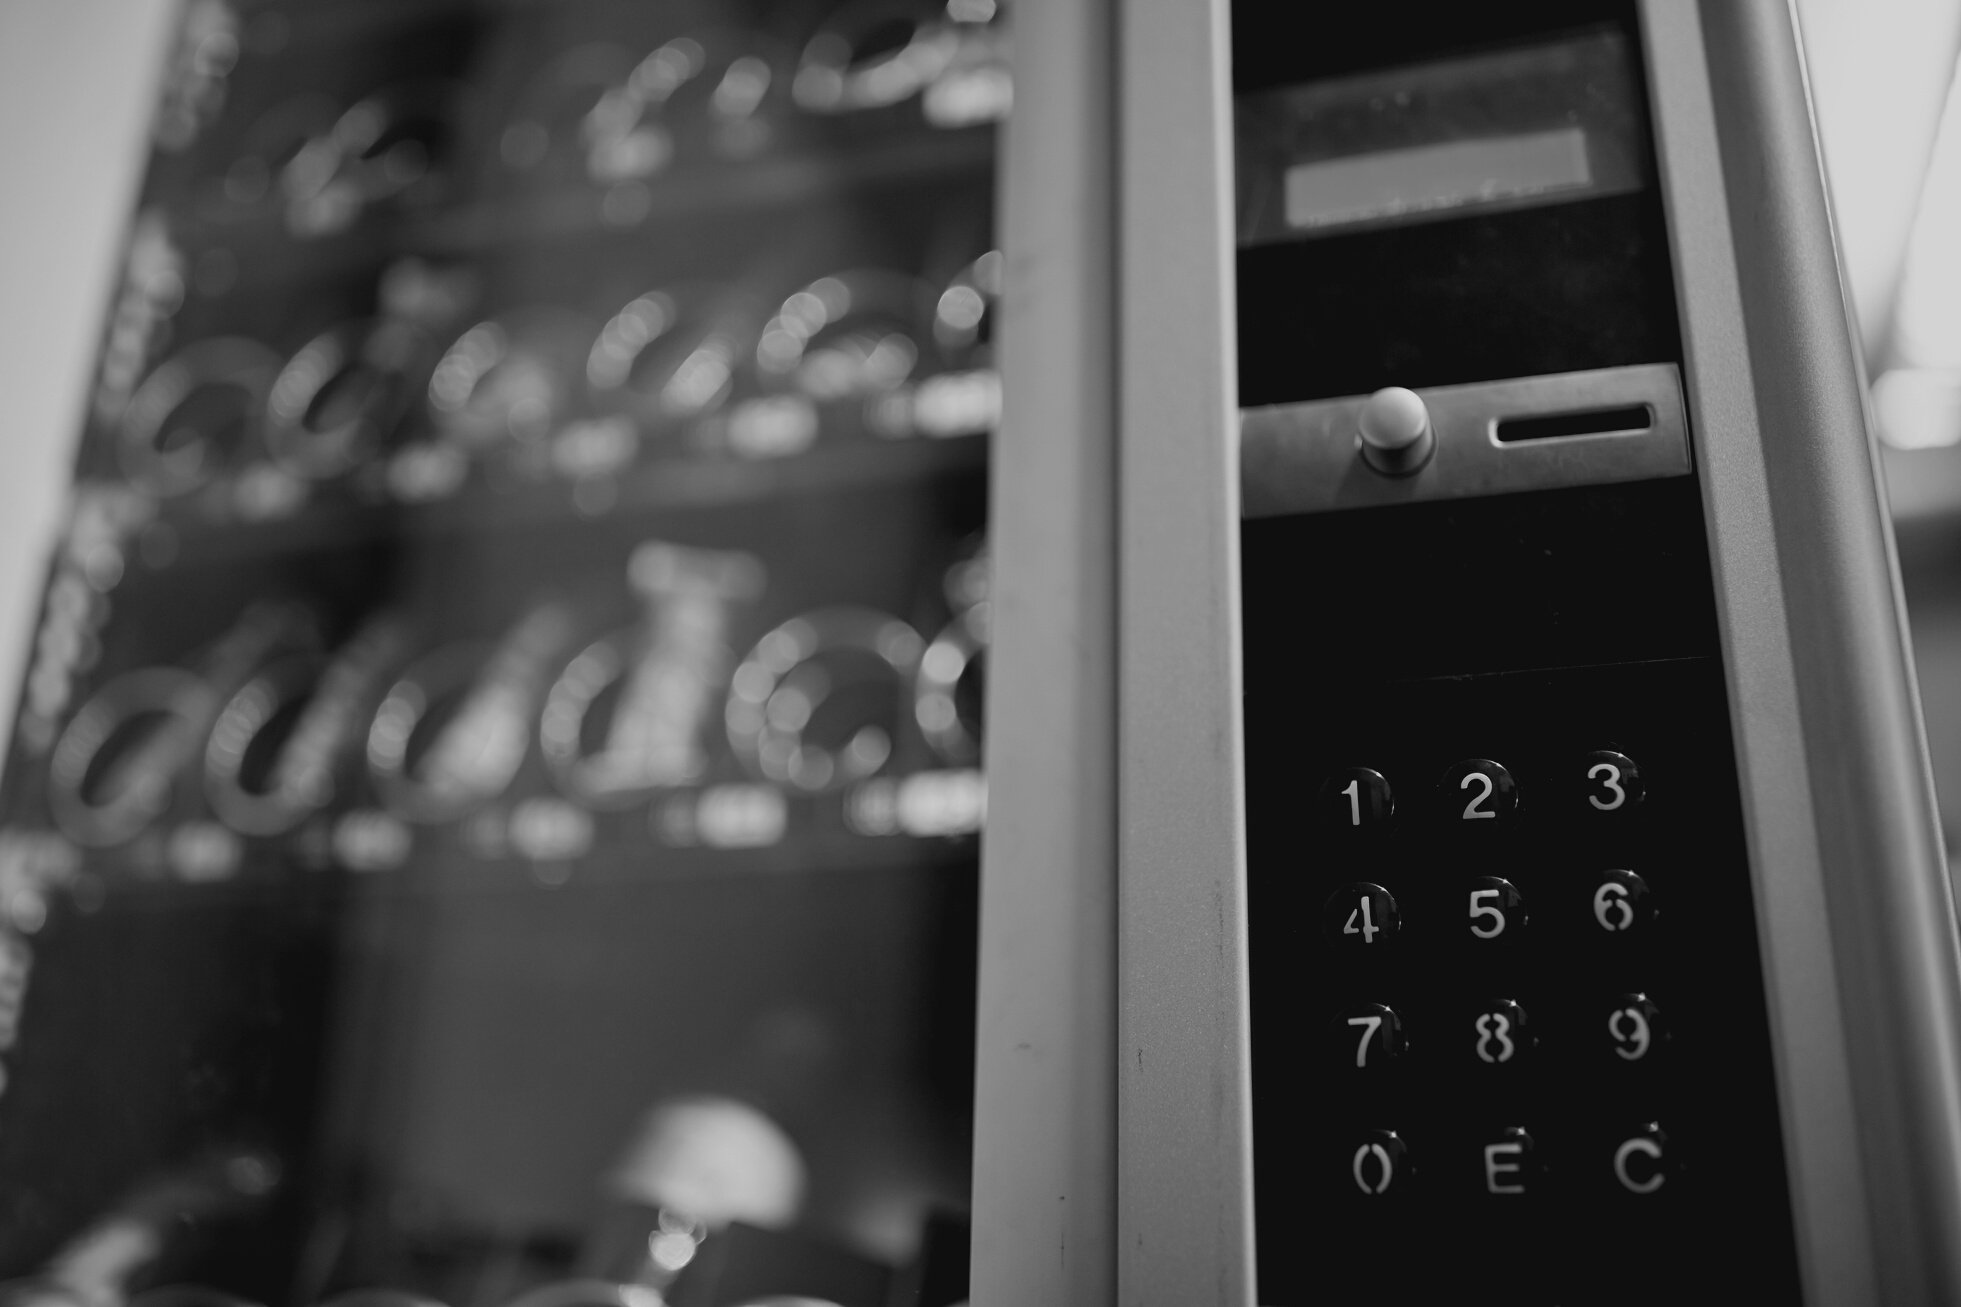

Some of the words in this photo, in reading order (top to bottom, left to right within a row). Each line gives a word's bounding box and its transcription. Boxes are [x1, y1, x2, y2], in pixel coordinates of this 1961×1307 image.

[1341, 780, 1360, 826] 1
[1460, 772, 1496, 819] 2
[1587, 763, 1625, 811] 3
[1343, 896, 1380, 943] 4
[1469, 889, 1505, 938] 5
[1593, 882, 1633, 931] 6
[1347, 1016, 1382, 1067] 7
[1475, 1013, 1514, 1063] 8
[1608, 1008, 1650, 1061] 9
[1353, 1143, 1393, 1195] 0
[1484, 1142, 1525, 1194] E
[1613, 1137, 1665, 1194] C
